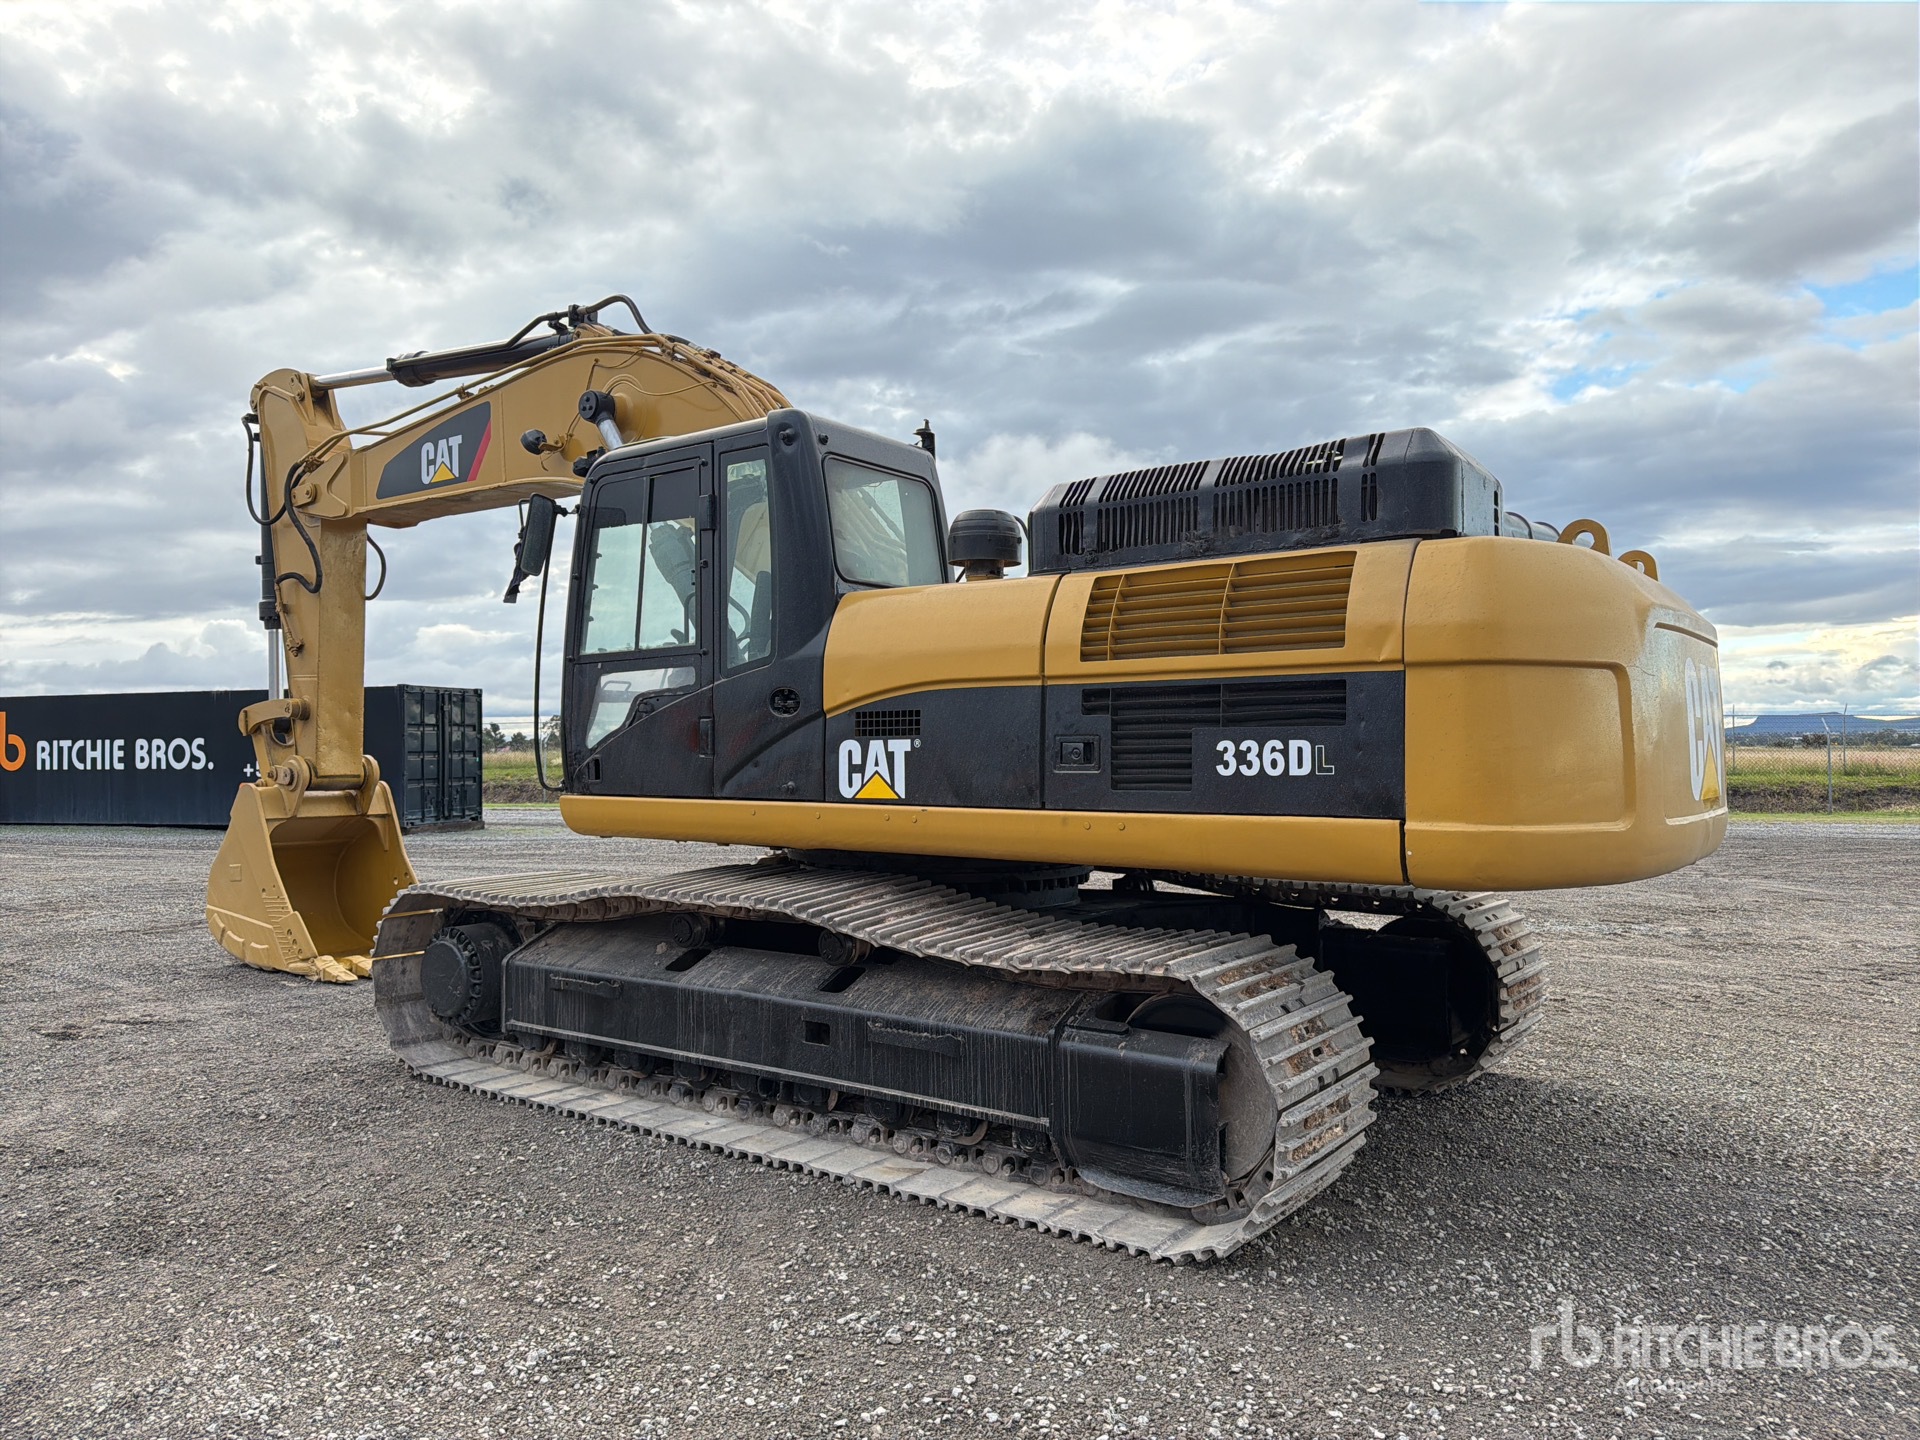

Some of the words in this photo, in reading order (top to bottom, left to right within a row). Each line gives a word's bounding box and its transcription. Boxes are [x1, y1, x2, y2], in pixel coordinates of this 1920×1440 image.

[421, 434, 463, 485] CAT
[36, 740, 125, 770] RITCHIE
[135, 738, 214, 770] BROS.
[1684, 657, 1723, 801] CAT
